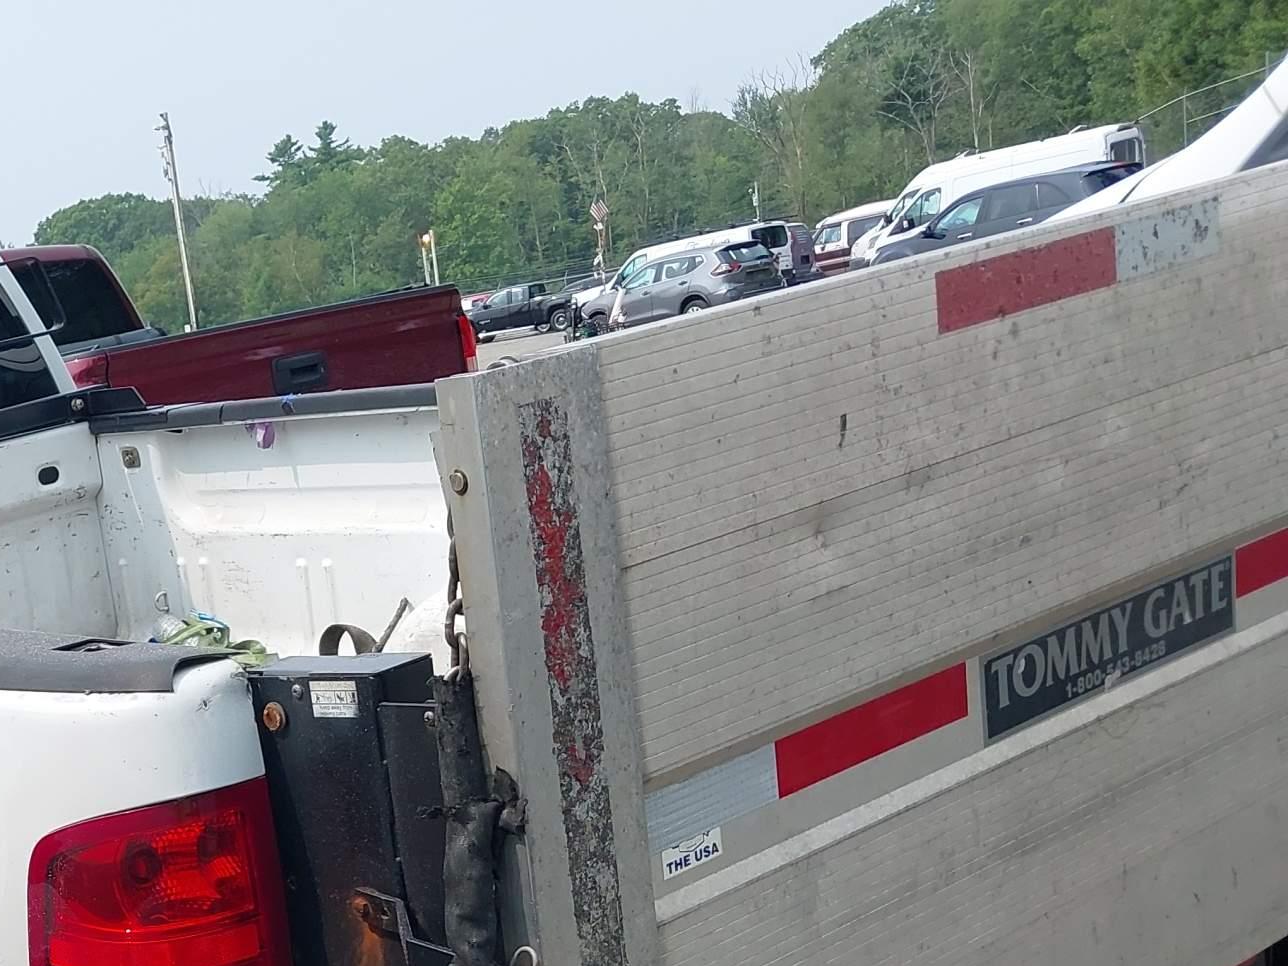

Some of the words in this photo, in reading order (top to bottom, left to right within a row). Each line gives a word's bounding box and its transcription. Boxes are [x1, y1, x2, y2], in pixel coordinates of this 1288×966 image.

[991, 602, 1133, 709] TOMMY
[1143, 563, 1229, 639] GATE
[666, 853, 692, 875] THE
[694, 842, 720, 862] USA
